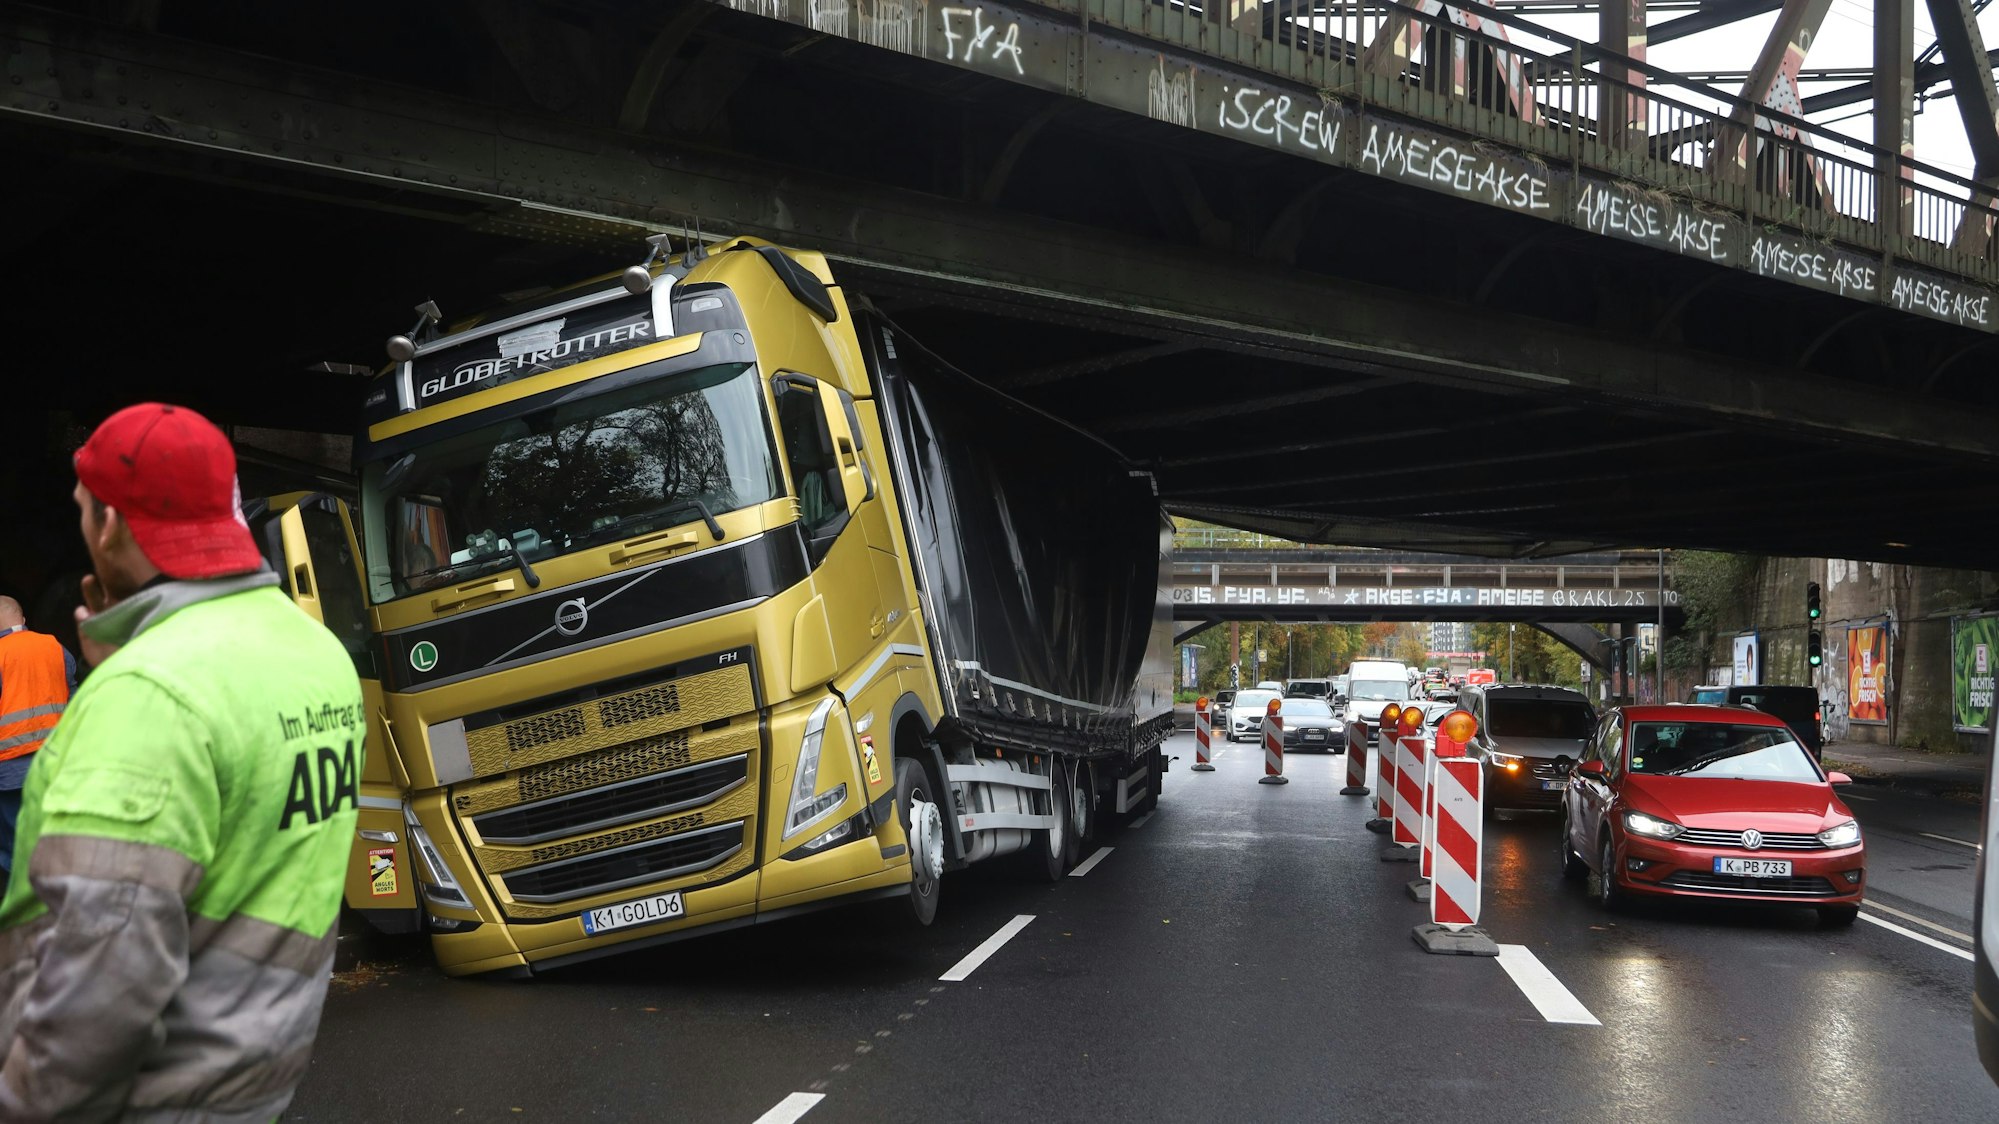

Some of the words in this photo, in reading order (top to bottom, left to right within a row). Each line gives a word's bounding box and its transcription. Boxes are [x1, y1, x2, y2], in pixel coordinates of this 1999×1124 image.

[1669, 212, 1727, 259] AKSE
[1365, 588, 1413, 605] AKSE
[1478, 588, 1545, 605] AMEISE
[559, 612, 583, 623] VOLVO
[418, 648, 433, 667] L
[718, 651, 738, 665] FH
[1970, 676, 1995, 690] RICHTIG
[278, 711, 304, 741] Im
[305, 702, 355, 732] Auftrag
[278, 735, 366, 831] ADA
[1726, 859, 1734, 872] K
[1743, 860, 1760, 873] PB
[1763, 861, 1786, 874] 733
[622, 894, 679, 922] GOLD6
